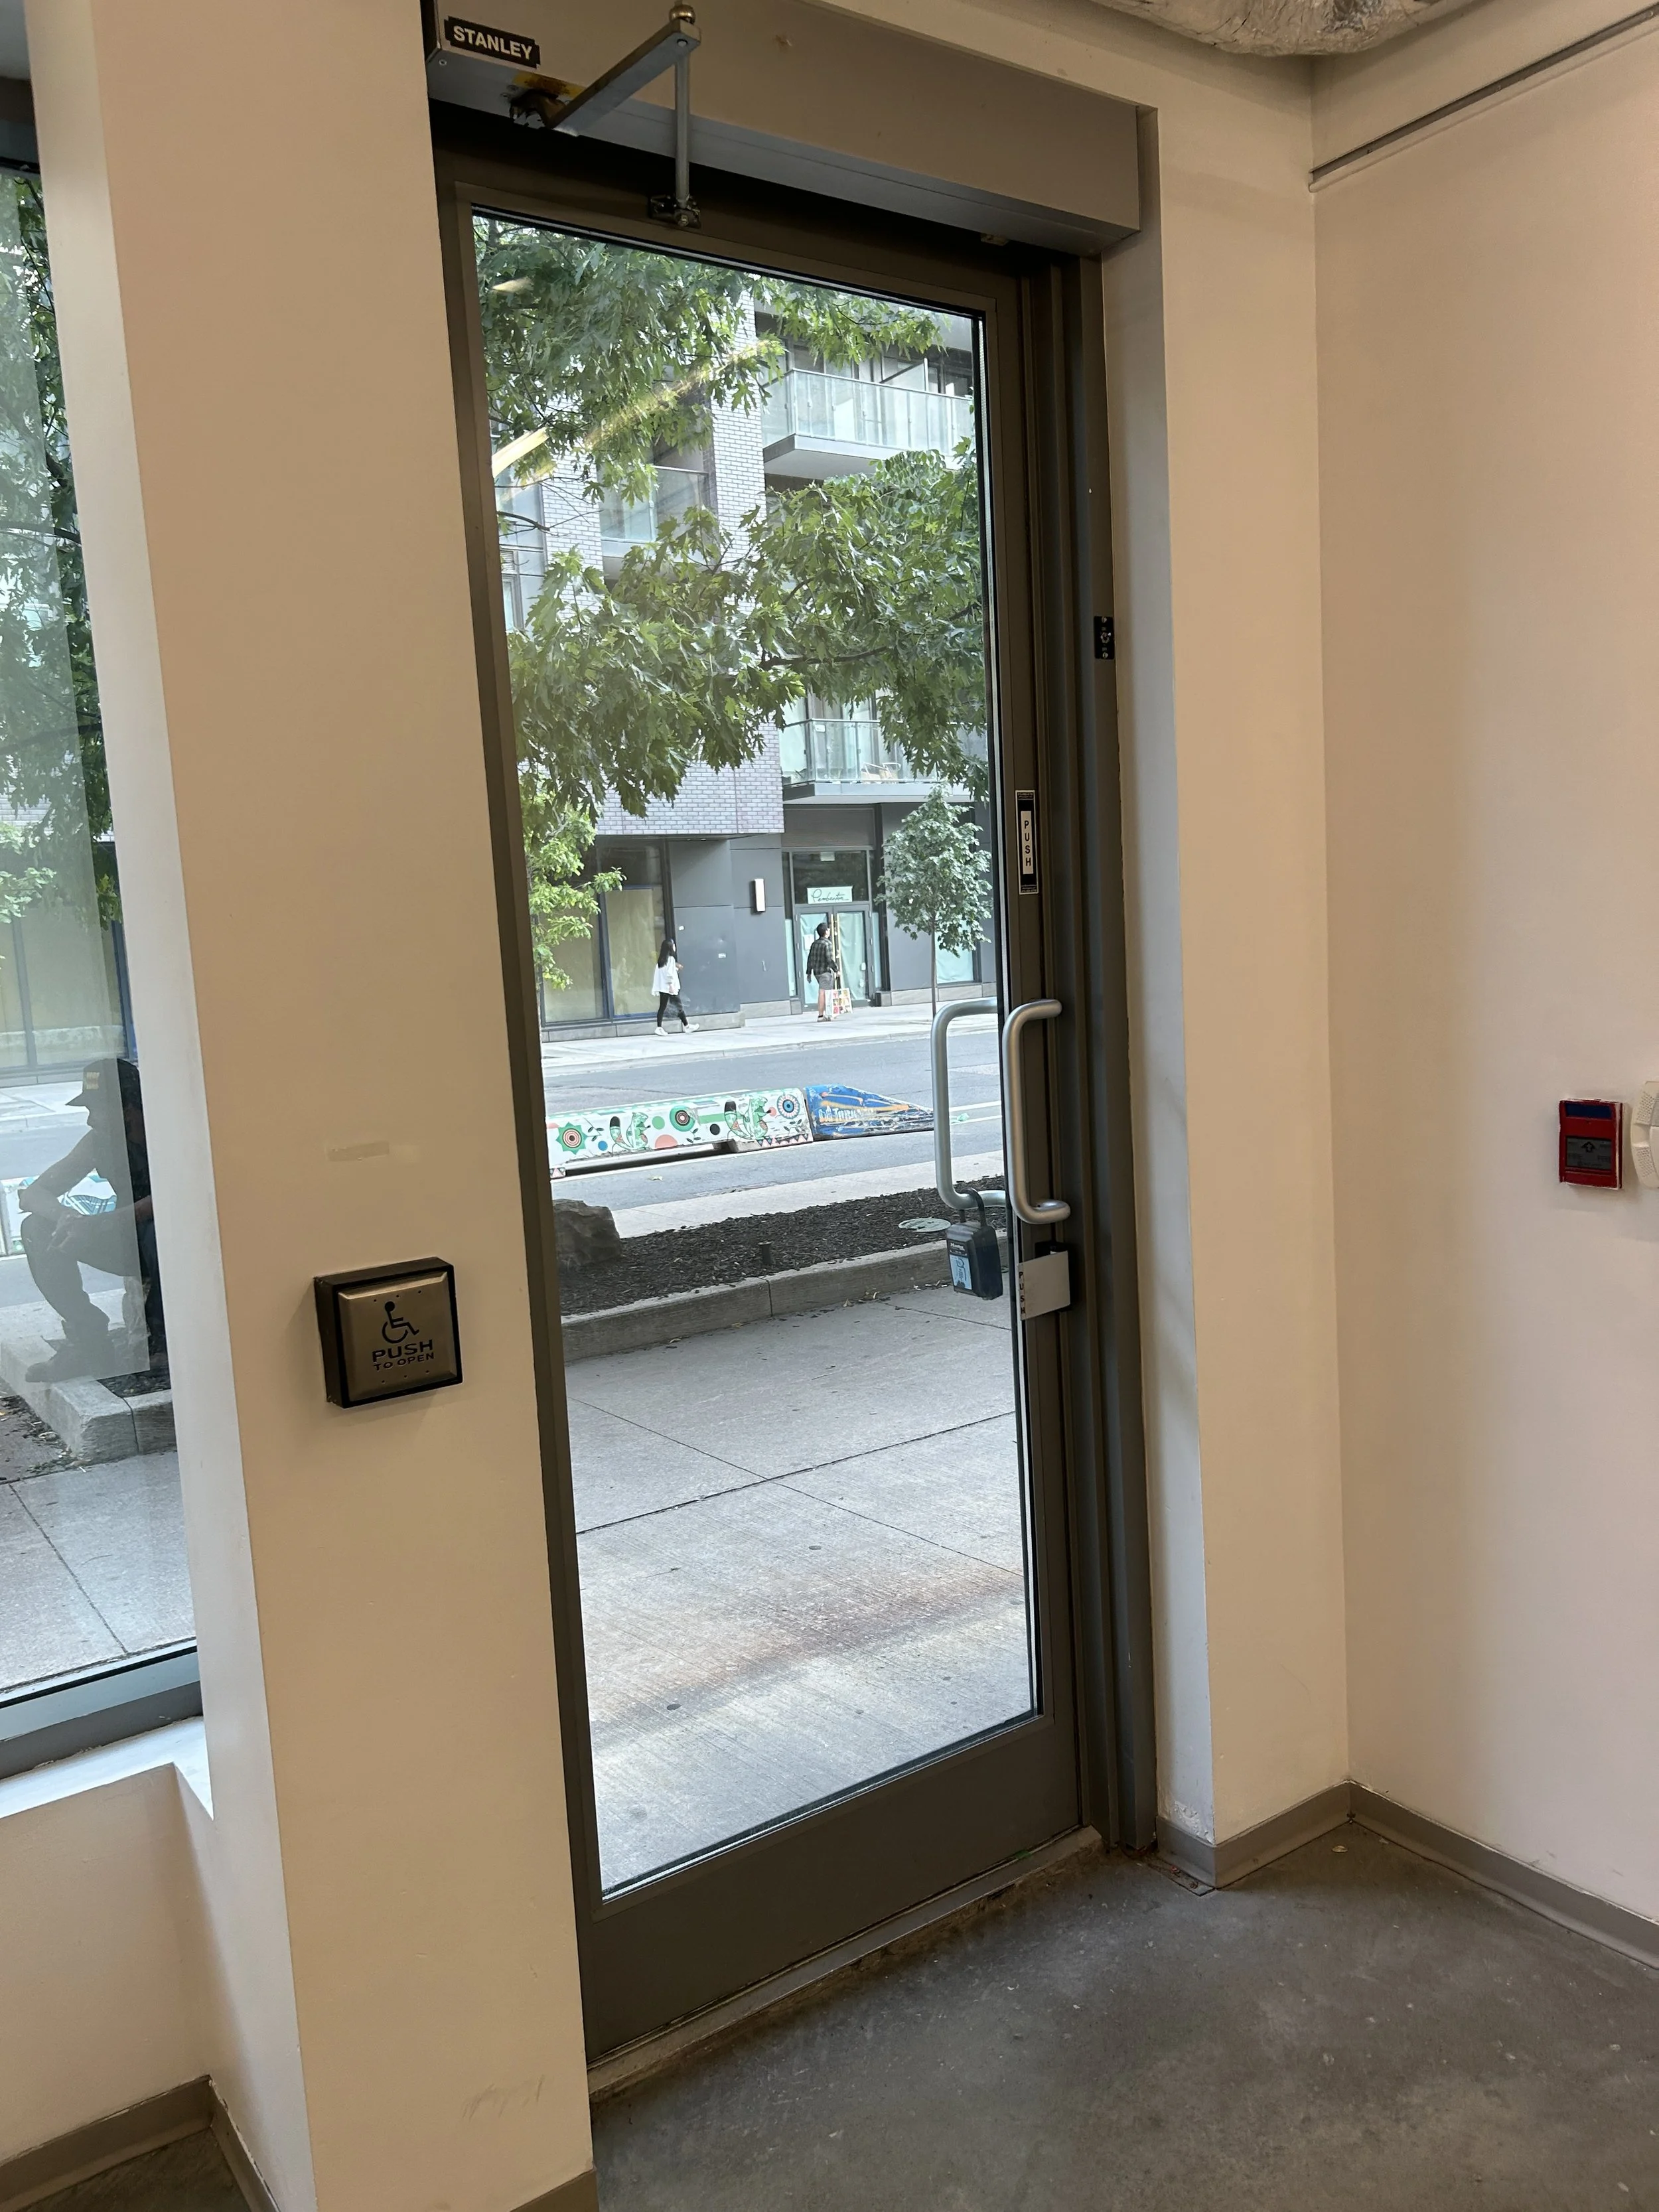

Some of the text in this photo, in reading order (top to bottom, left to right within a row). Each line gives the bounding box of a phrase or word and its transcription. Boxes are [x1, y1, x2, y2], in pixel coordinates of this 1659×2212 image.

[453, 25, 533, 61] STANLEY
[372, 1339, 433, 1363] PUSH
[374, 1352, 435, 1371] TO OPEN
